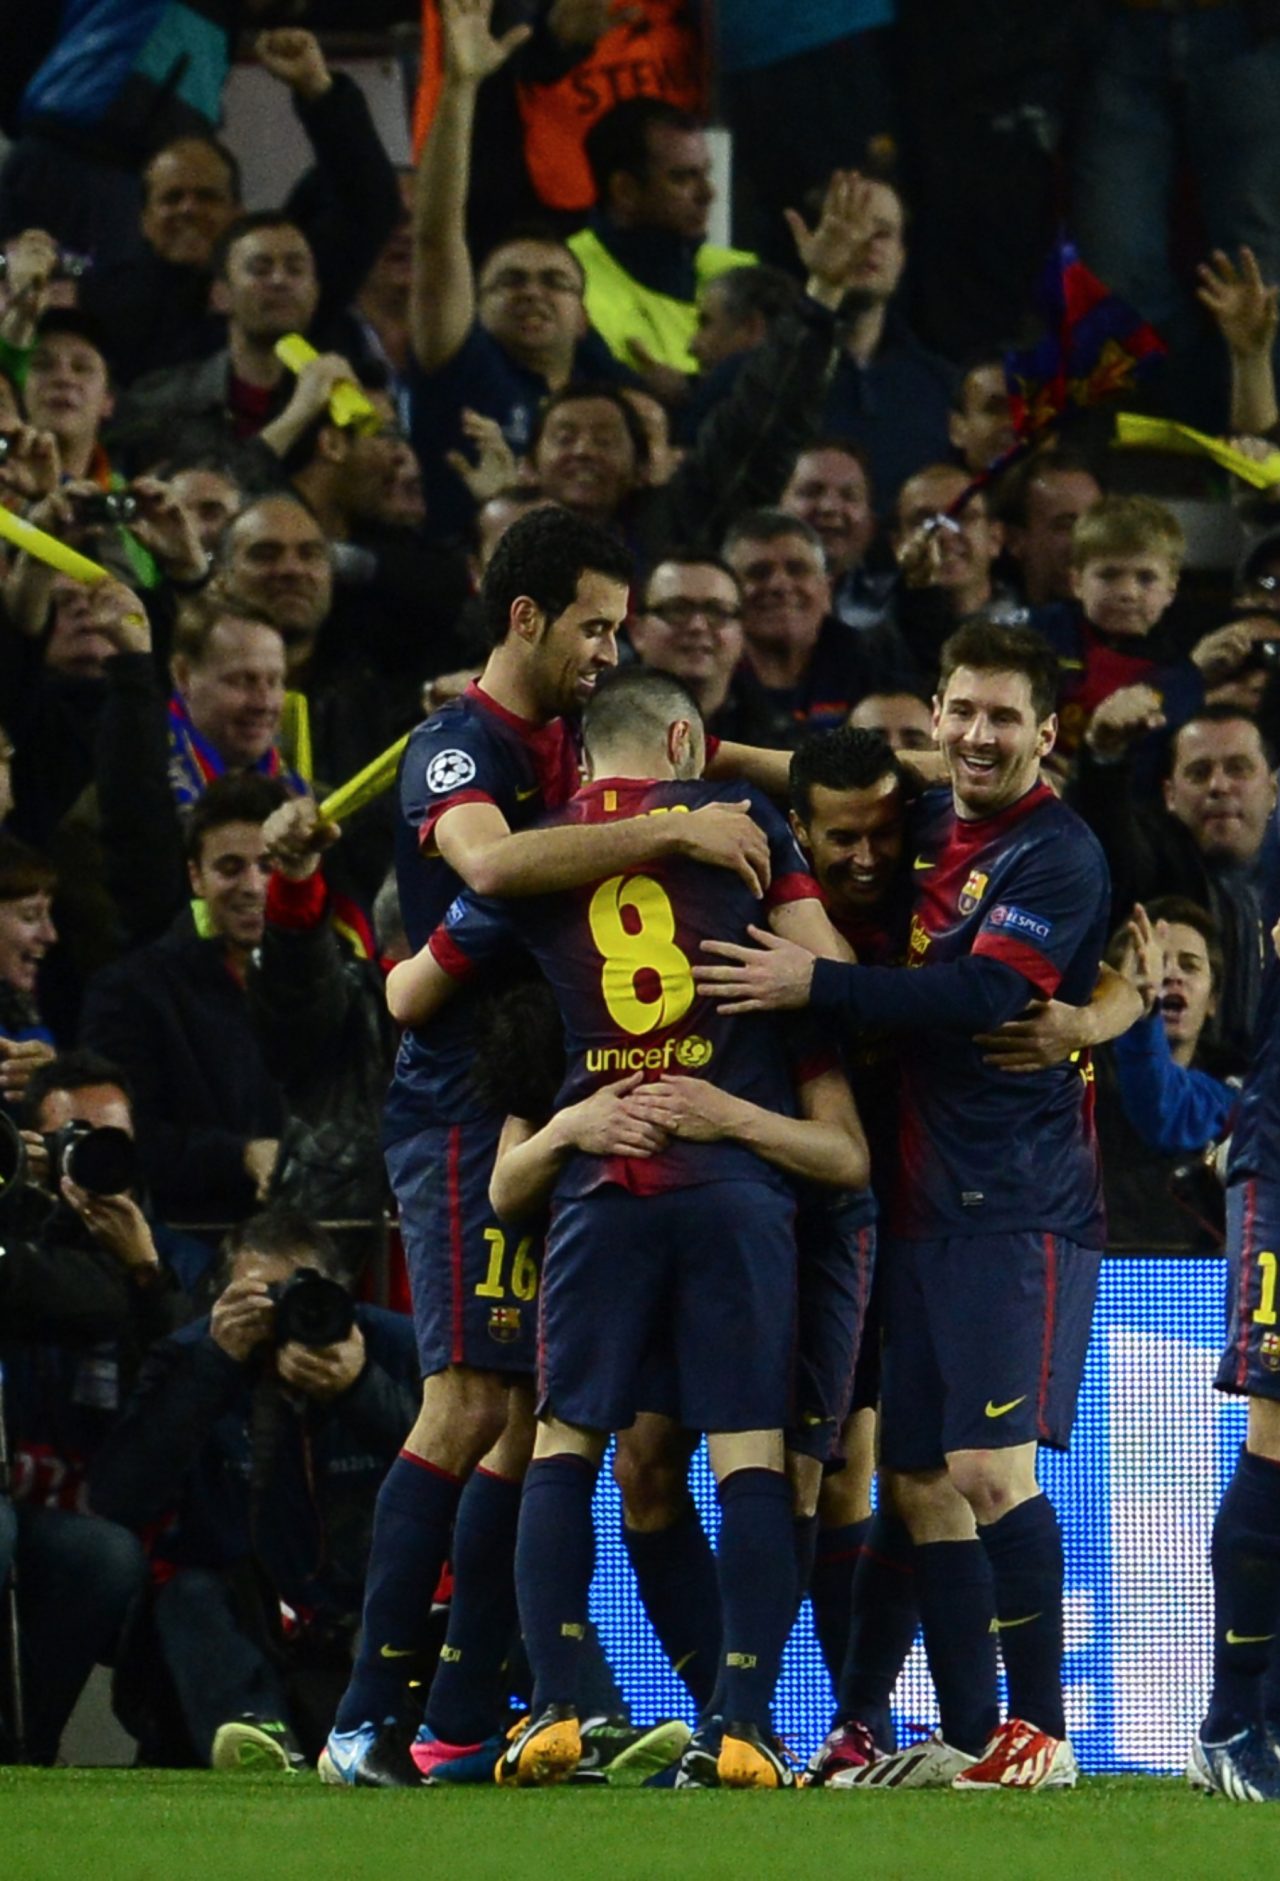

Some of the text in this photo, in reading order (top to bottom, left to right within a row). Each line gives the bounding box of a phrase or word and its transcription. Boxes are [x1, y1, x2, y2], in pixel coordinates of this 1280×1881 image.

[588, 874, 695, 1036] 8
[586, 1038, 677, 1072] unicef
[474, 1226, 538, 1301] 16
